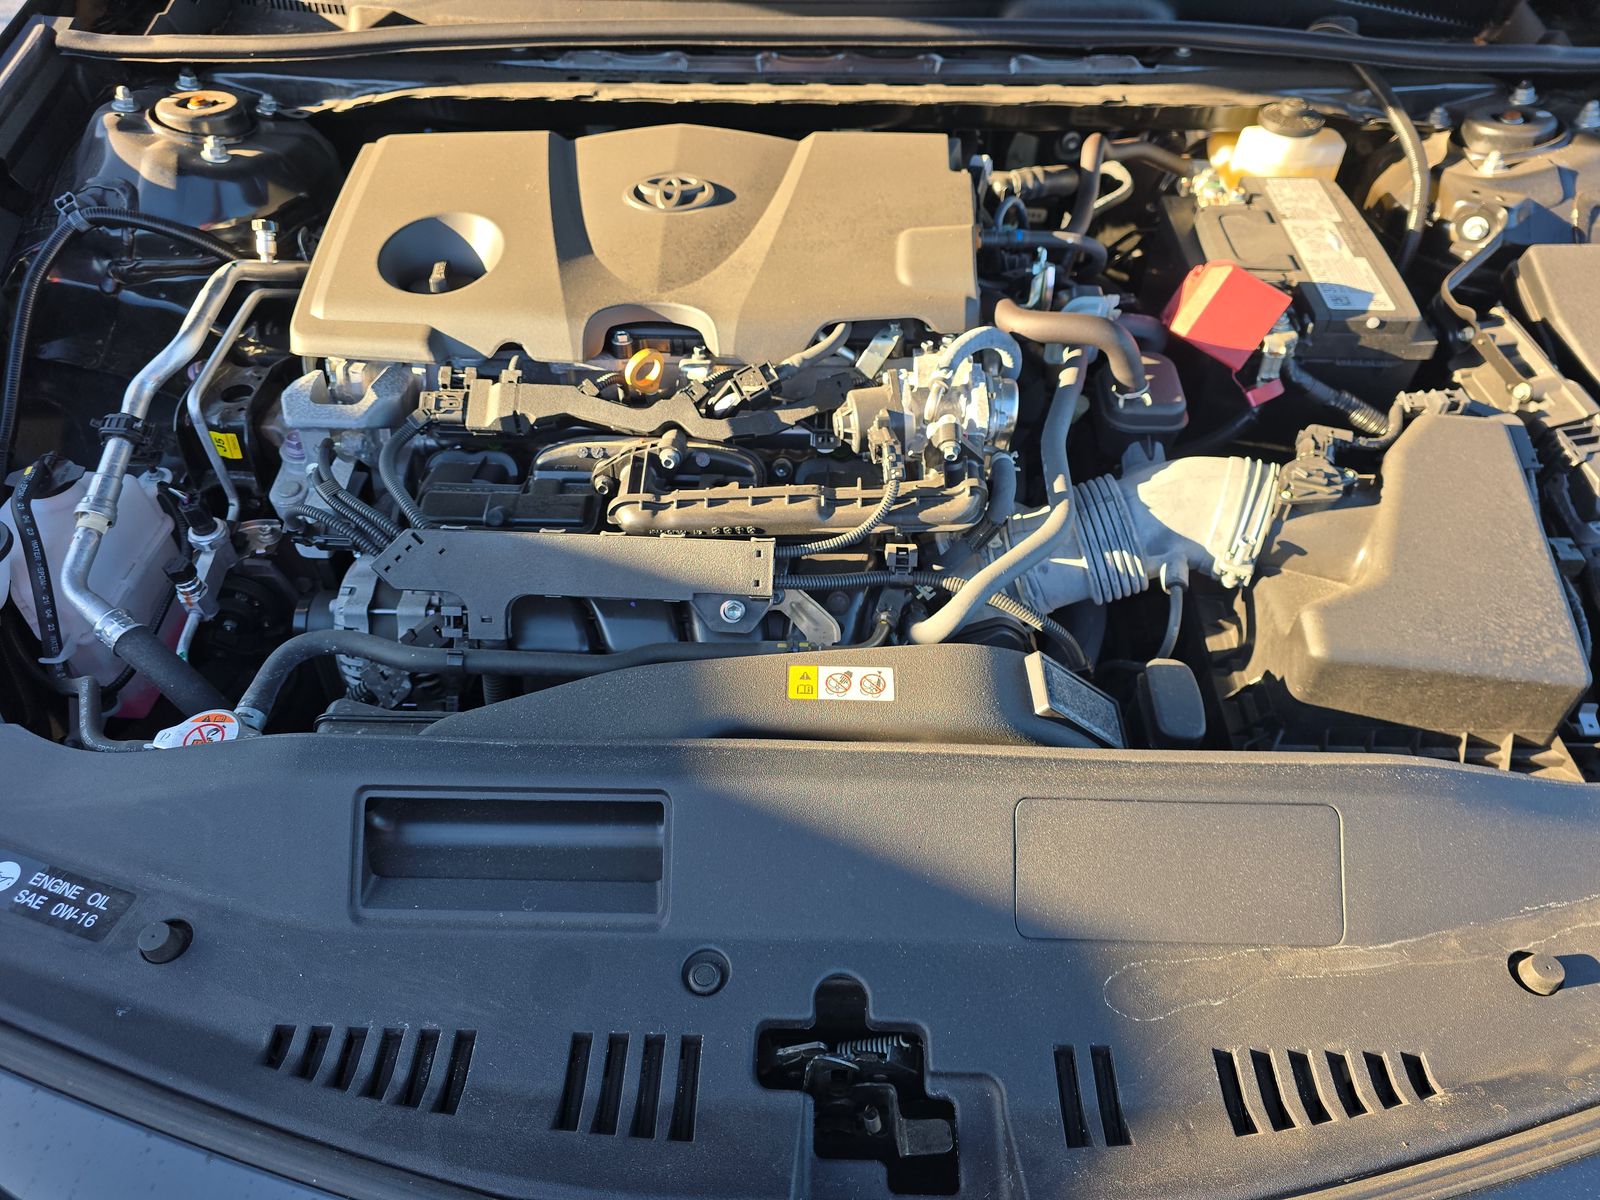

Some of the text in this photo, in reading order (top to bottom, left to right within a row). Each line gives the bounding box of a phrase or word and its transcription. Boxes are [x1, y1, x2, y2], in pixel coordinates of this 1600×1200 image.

[14, 889, 99, 928] SAE 0W-16
[28, 871, 110, 911] ENGINE OIL
